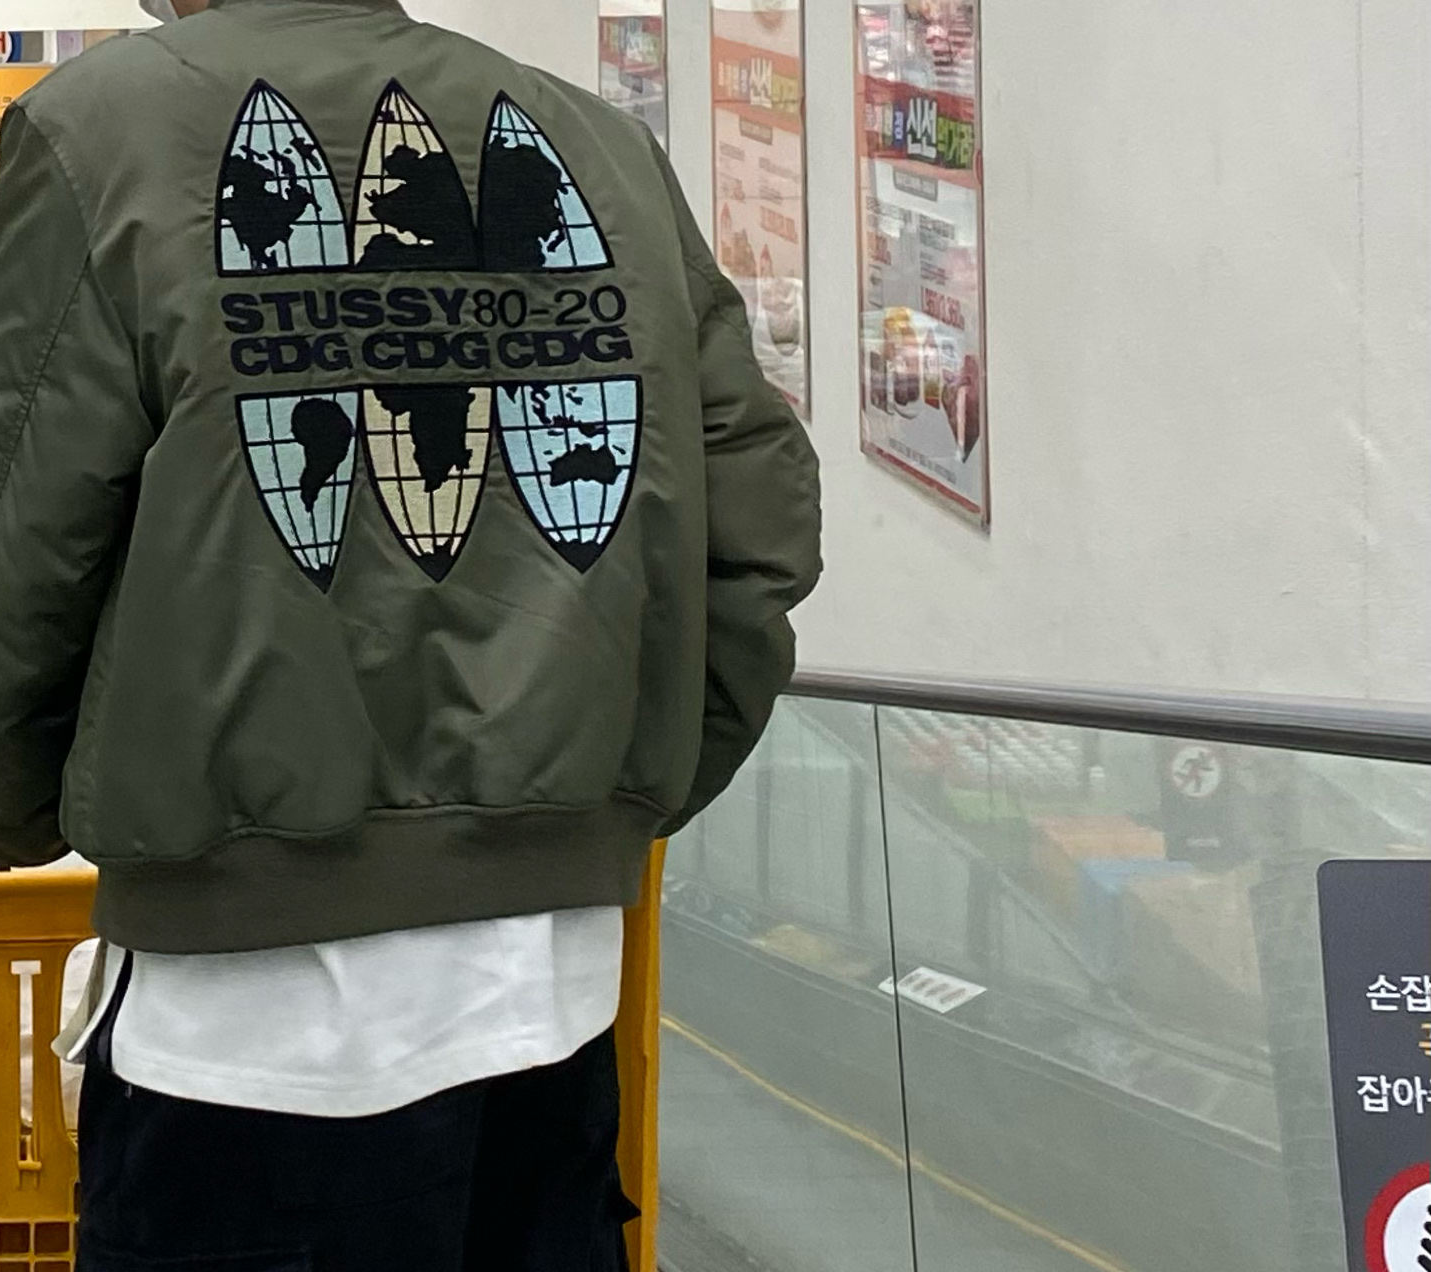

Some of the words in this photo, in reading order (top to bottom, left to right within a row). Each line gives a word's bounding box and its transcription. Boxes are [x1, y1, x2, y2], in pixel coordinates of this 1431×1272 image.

[220, 286, 470, 334] STUSSY
[473, 284, 628, 329] 80-20
[229, 332, 354, 377] CDG
[361, 330, 492, 371] CDG
[497, 327, 635, 368] CDG
[1356, 1074, 1431, 1114] 잡아
